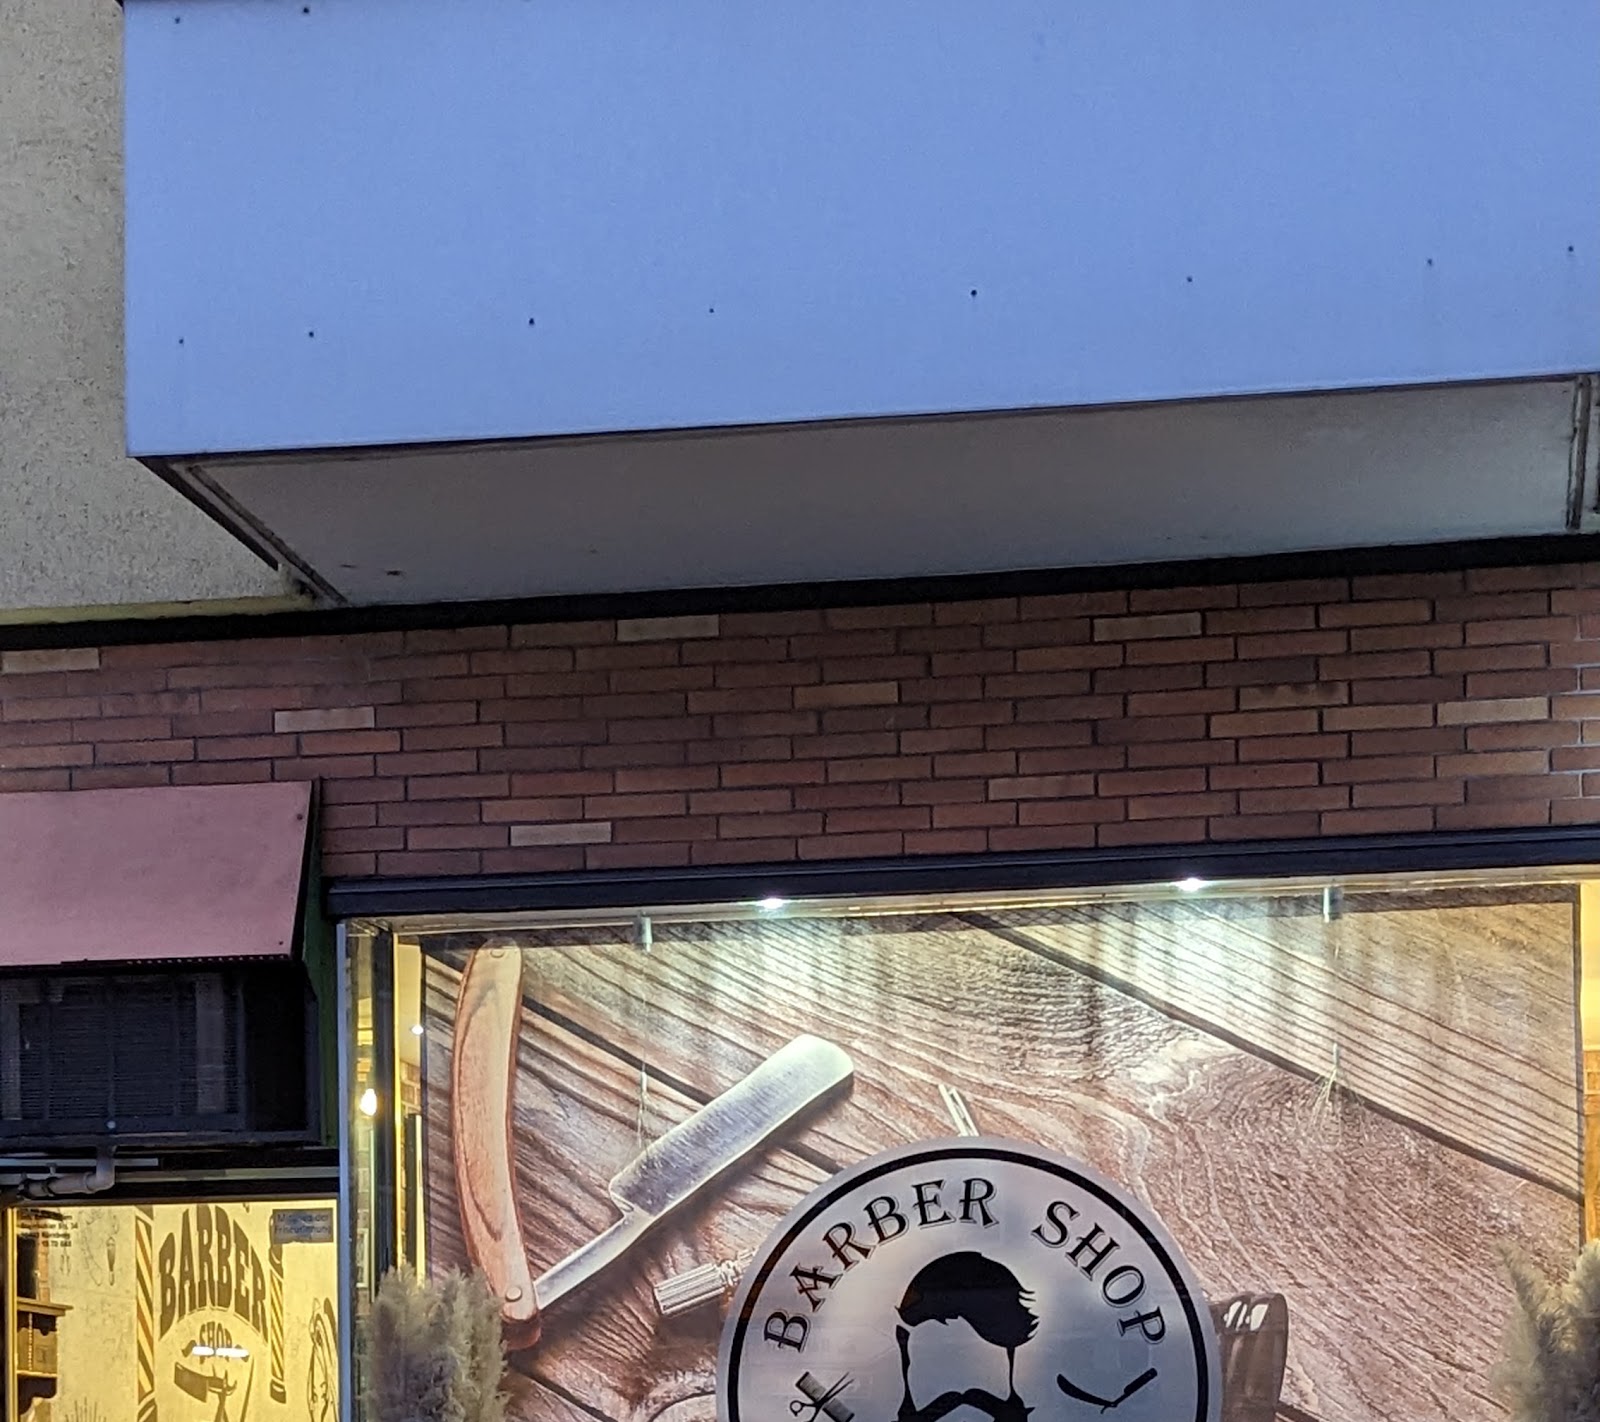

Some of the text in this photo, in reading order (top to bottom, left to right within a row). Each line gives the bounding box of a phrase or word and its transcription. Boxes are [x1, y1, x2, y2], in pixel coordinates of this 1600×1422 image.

[158, 1203, 269, 1346] BARBER
[764, 1178, 1167, 1352] BARBER SHOP
